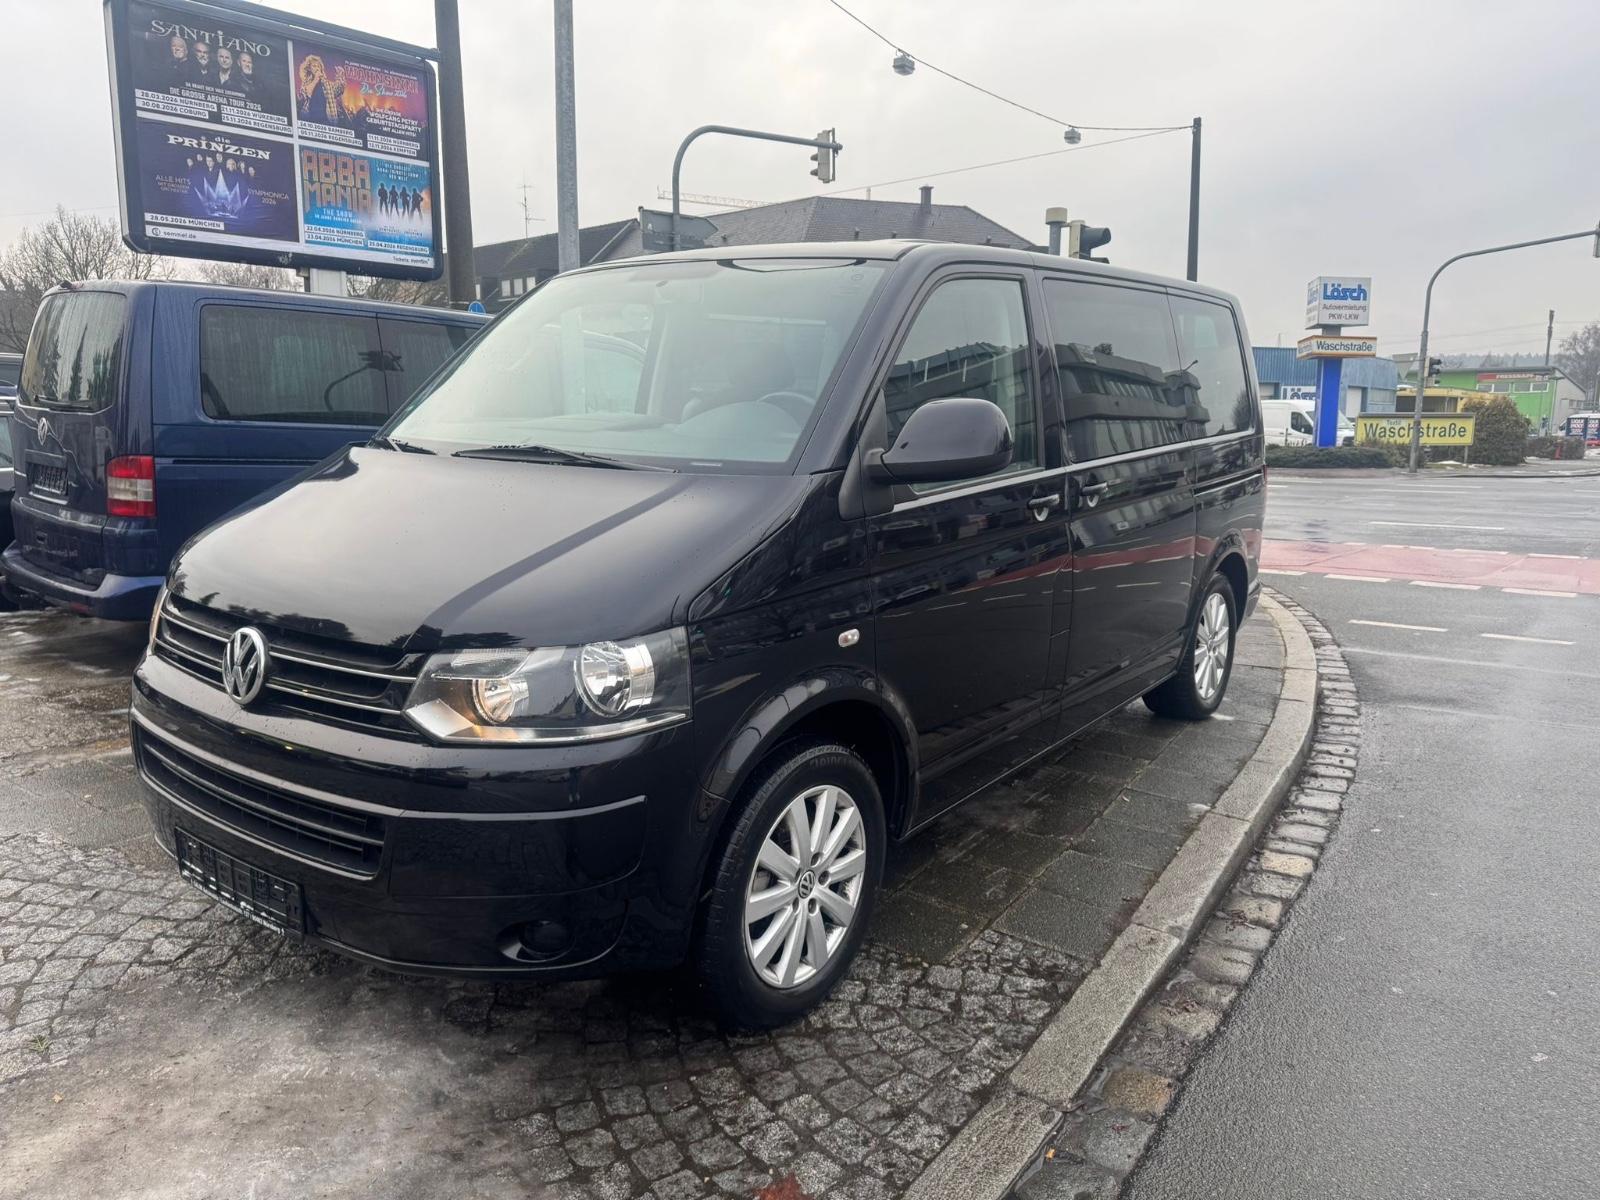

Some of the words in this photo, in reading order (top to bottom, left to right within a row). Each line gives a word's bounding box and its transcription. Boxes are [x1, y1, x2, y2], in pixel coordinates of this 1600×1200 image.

[151, 19, 271, 57] SANTIANO
[180, 97, 215, 111] NÜRNBERG
[207, 94, 228, 105] ARENA
[229, 98, 245, 108] TOUR
[179, 106, 207, 118] COBURG
[253, 120, 292, 133] REGENSBURG
[167, 134, 271, 160] PRINZEN
[215, 136, 231, 144] die
[302, 150, 371, 188] ABBA
[303, 181, 372, 212] MANIA
[188, 218, 221, 228] MÜNCHEN
[1323, 283, 1367, 301] Lösch
[1322, 304, 1367, 312] Autovermietung
[1316, 341, 1373, 352] Waschstraße
[1364, 422, 1467, 438] Waschstraße
